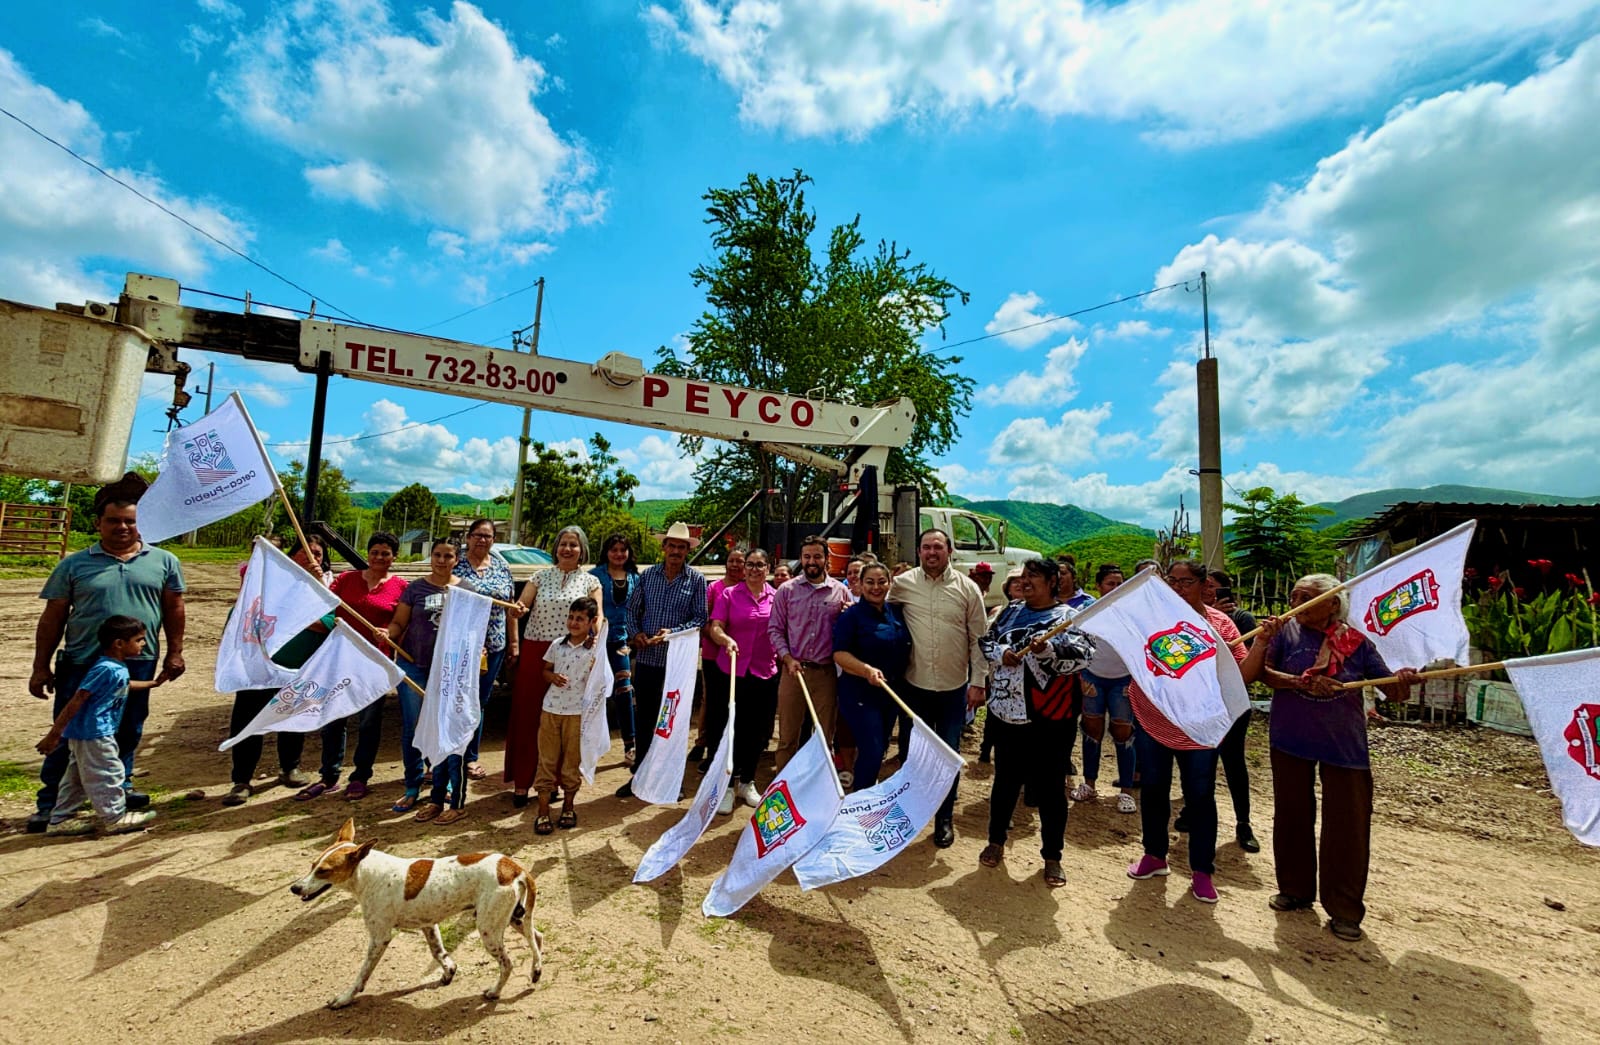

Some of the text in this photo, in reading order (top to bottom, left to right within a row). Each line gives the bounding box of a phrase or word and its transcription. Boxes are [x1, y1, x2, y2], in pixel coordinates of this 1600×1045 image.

[345, 342, 556, 395] TEL. 732-83-00
[643, 377, 814, 427] PEYCO
